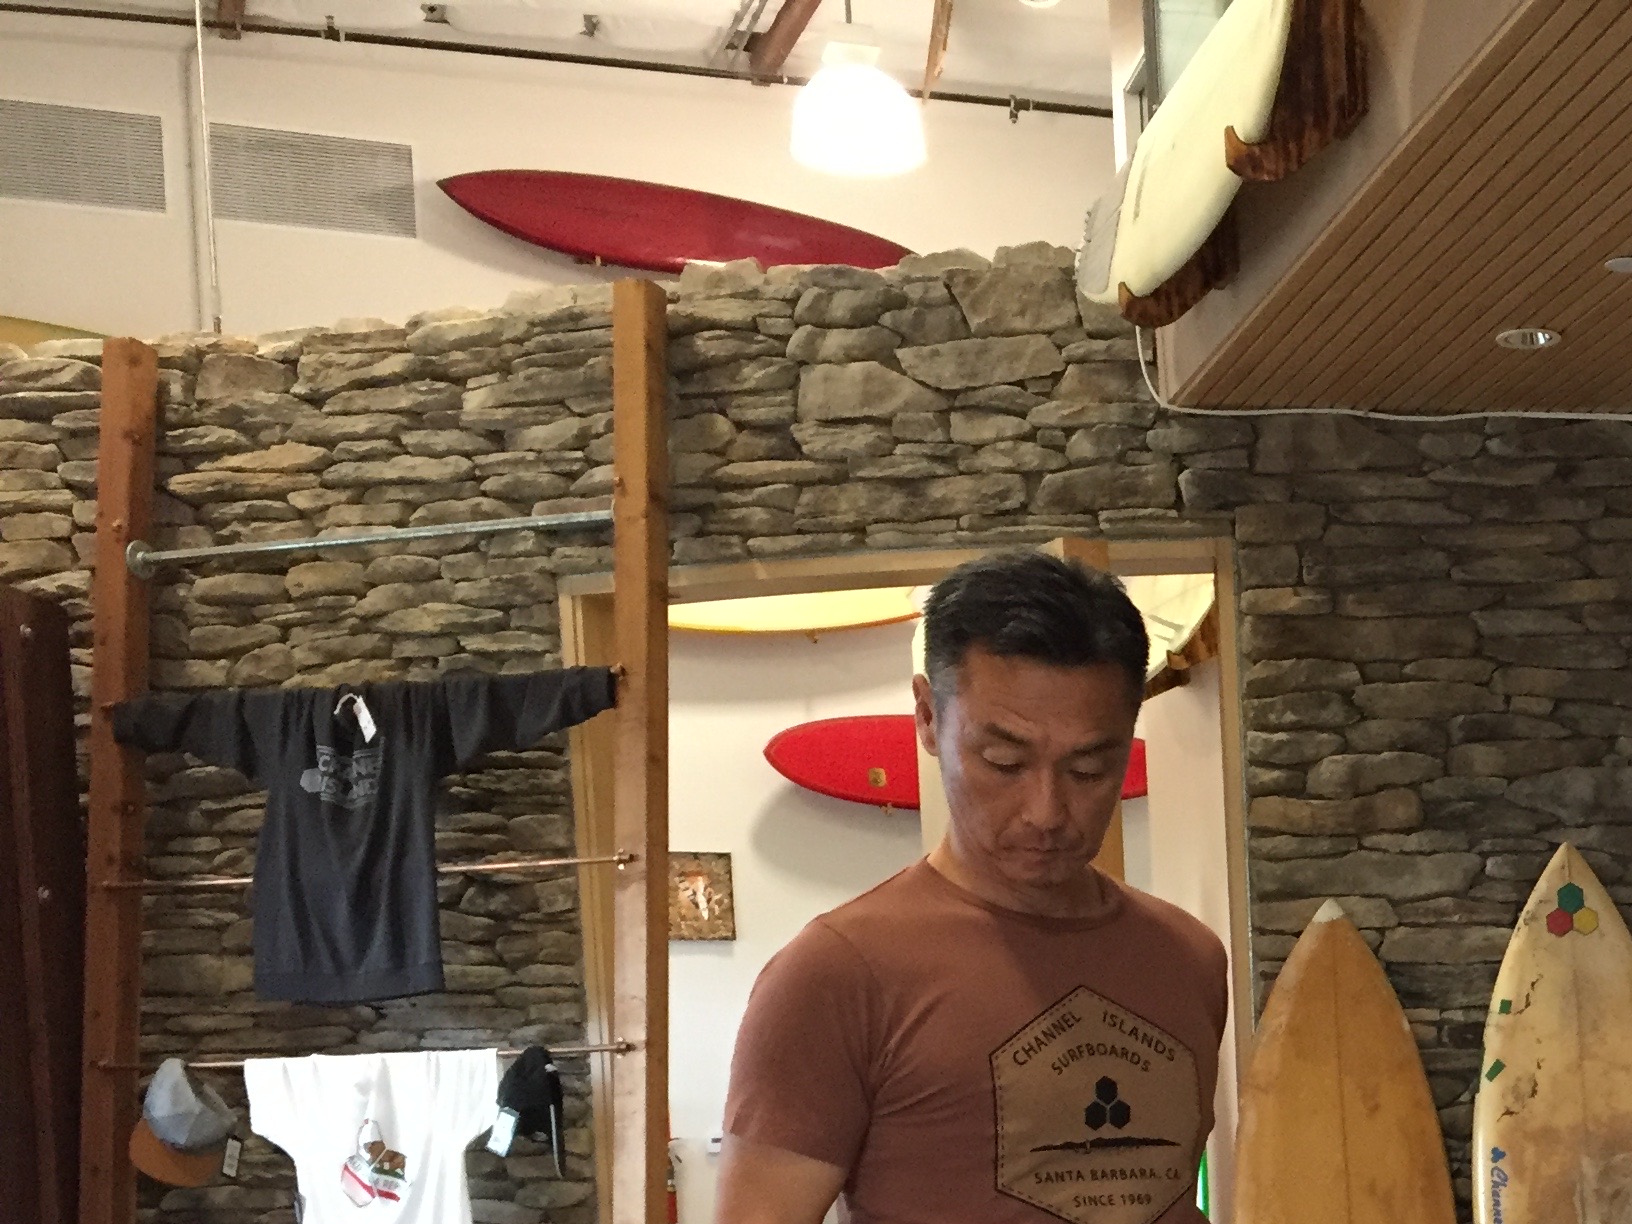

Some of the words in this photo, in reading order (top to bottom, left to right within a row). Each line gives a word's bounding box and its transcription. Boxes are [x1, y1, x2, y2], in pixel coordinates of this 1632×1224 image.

[1012, 1010, 1082, 1066] CHANNEL
[1102, 1010, 1175, 1062] ISLANDS
[1051, 1043, 1151, 1076] SURFBOARDS
[1035, 1169, 1085, 1184] SANTA
[1165, 1168, 1181, 1180] CA
[1073, 1193, 1116, 1208] SINCE
[1120, 1193, 1152, 1207] 1969
